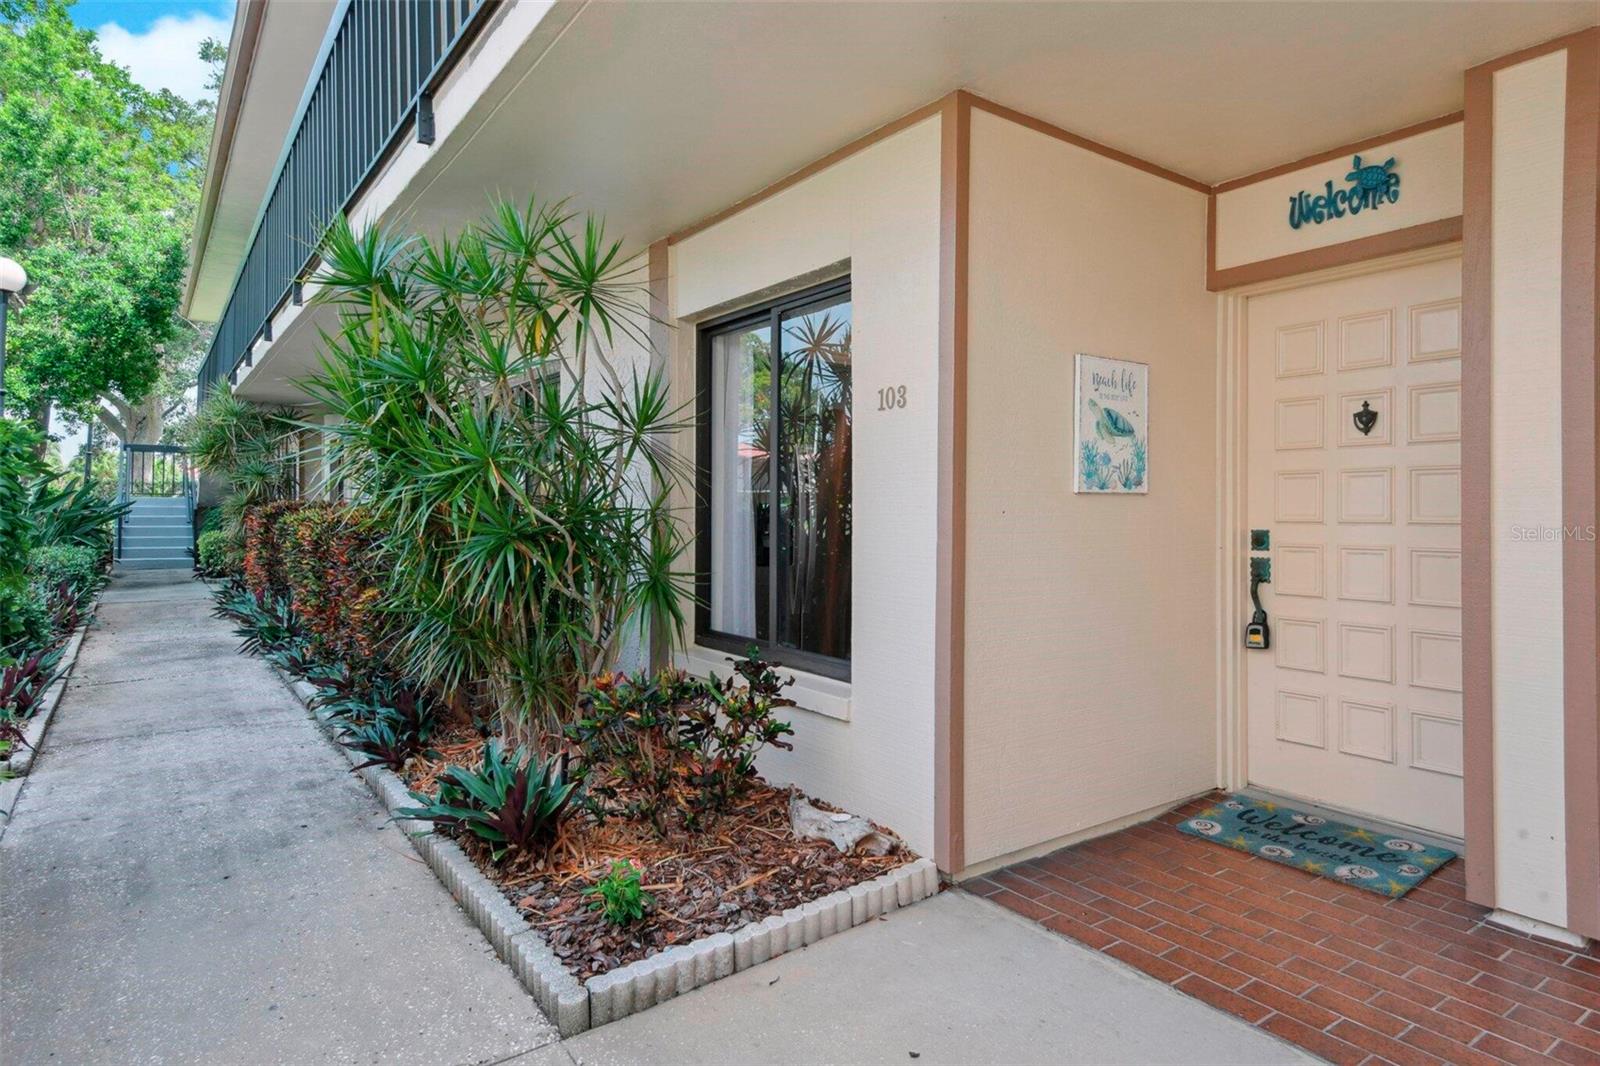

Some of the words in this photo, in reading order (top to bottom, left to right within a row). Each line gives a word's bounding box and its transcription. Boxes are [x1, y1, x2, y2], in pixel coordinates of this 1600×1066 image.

[1289, 172, 1401, 229] Welcome
[877, 384, 907, 411] 103
[1236, 808, 1408, 862] Welcome
[1238, 826, 1259, 835] to
[1261, 833, 1290, 846] the
[1294, 842, 1354, 864] beach
